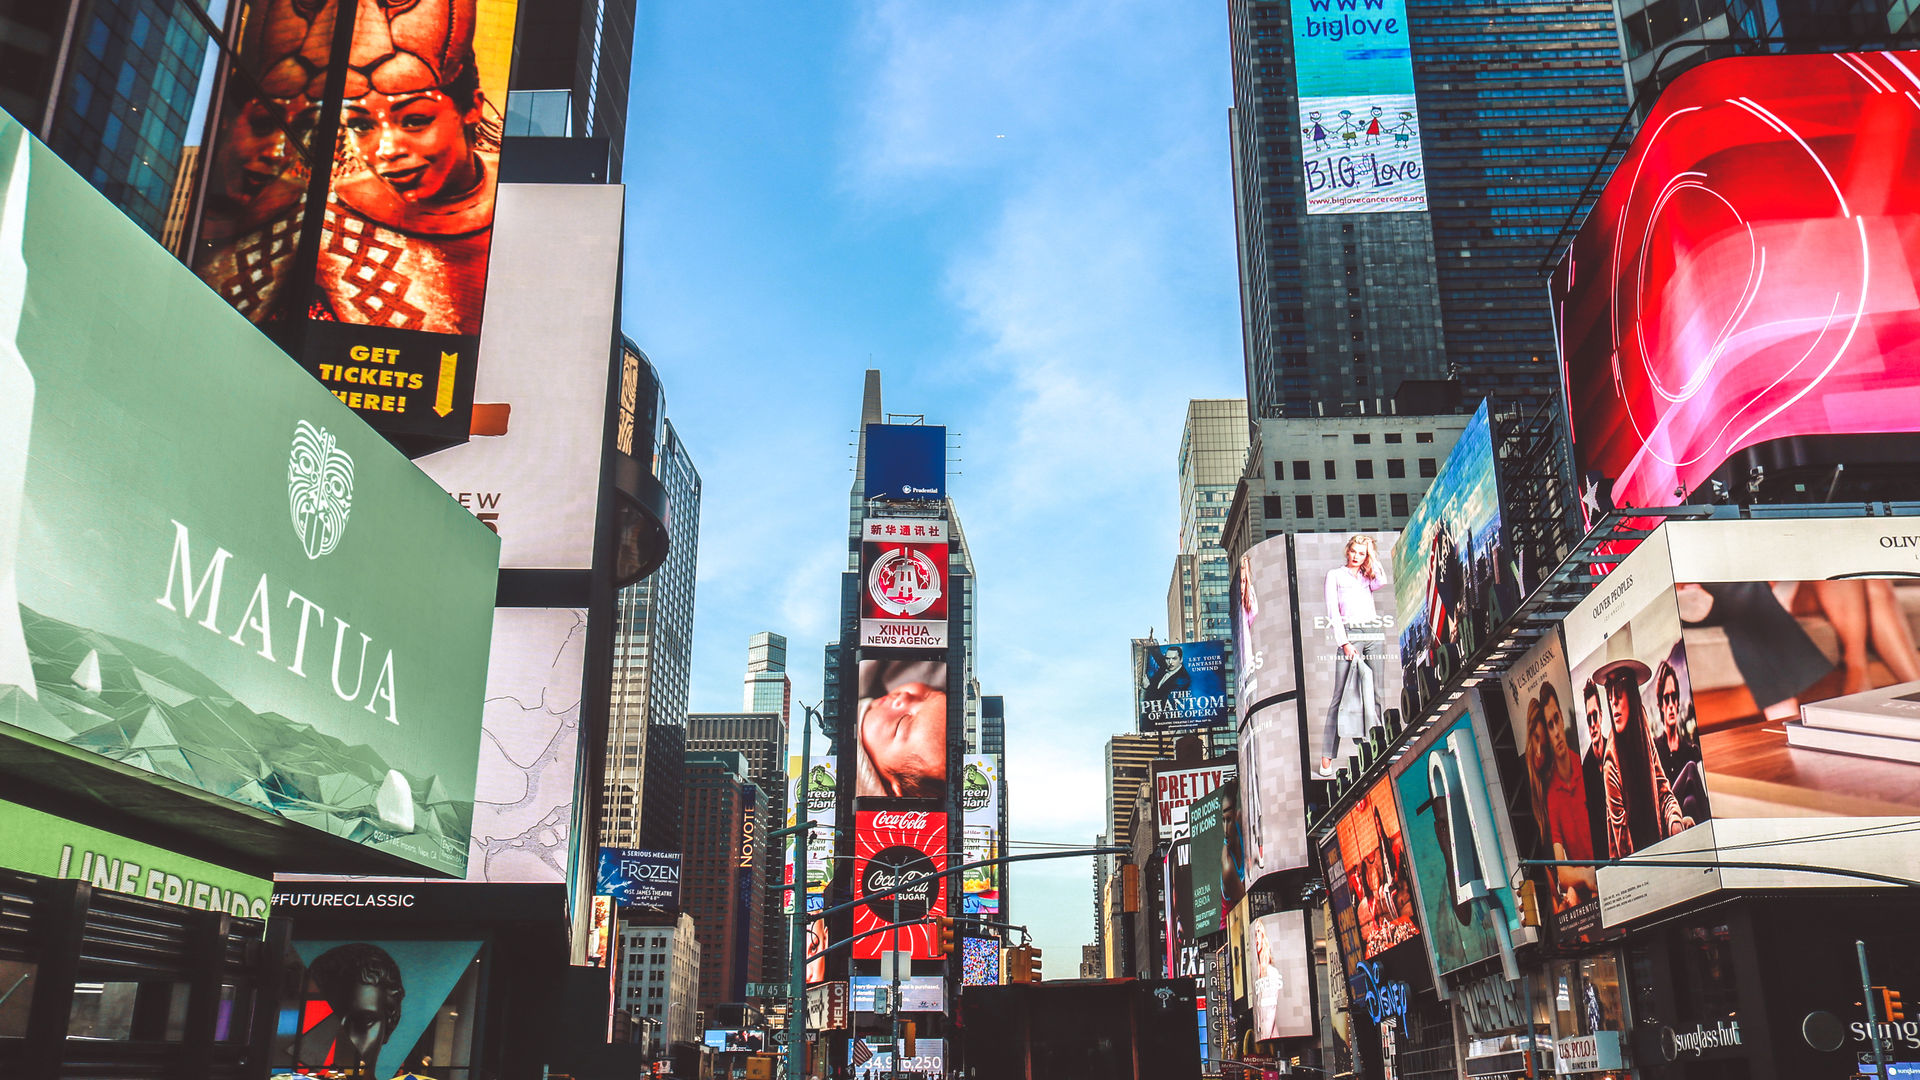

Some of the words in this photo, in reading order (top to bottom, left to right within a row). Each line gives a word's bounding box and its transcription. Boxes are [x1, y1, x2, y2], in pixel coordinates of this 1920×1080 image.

[1371, 153, 1421, 187] Love
[1308, 196, 1425, 207] www.biglovecancercare.org
[350, 345, 400, 365] GET
[319, 363, 424, 390] TICKETS
[330, 389, 407, 413] HERE!
[448, 492, 501, 509] EW
[870, 524, 940, 537] 新华通讯社
[1592, 595, 1611, 619] OLIVER
[1610, 575, 1633, 603] PEOPLES
[156, 519, 400, 726] MATUA
[879, 624, 930, 636] XINHUA
[867, 635, 897, 644] NEWS
[899, 636, 941, 645] AGENCY
[1526, 660, 1540, 681] POLO
[1170, 690, 1192, 699] THE
[1140, 695, 1225, 714] PHANTOM
[1148, 712, 1161, 720] OF
[1163, 710, 1184, 719] THE
[1184, 708, 1218, 717] OPERA
[963, 789, 988, 797] reen
[1157, 770, 1222, 800] PRETTY
[873, 810, 930, 829] Coca-Cola
[1191, 809, 1202, 823] FOR
[1202, 797, 1220, 816] ICONS,
[1191, 823, 1200, 837] BY
[1200, 814, 1216, 833] ICONS
[620, 859, 679, 881] FROZEN
[271, 893, 415, 907] #FUTURECLASSIC
[652, 889, 673, 897] THEATRE
[1569, 901, 1599, 920] AUTHENTIC
[756, 985, 765, 995] W
[767, 985, 778, 995] 45
[833, 984, 844, 1026] HELLO!
[1209, 961, 1222, 1047] PALACE
[1675, 1023, 1719, 1057] sunglass
[1717, 1020, 1742, 1046] hut
[1851, 1021, 1920, 1049] sung
[1559, 1043, 1571, 1059] U.S.
[1571, 1040, 1590, 1058] POLO
